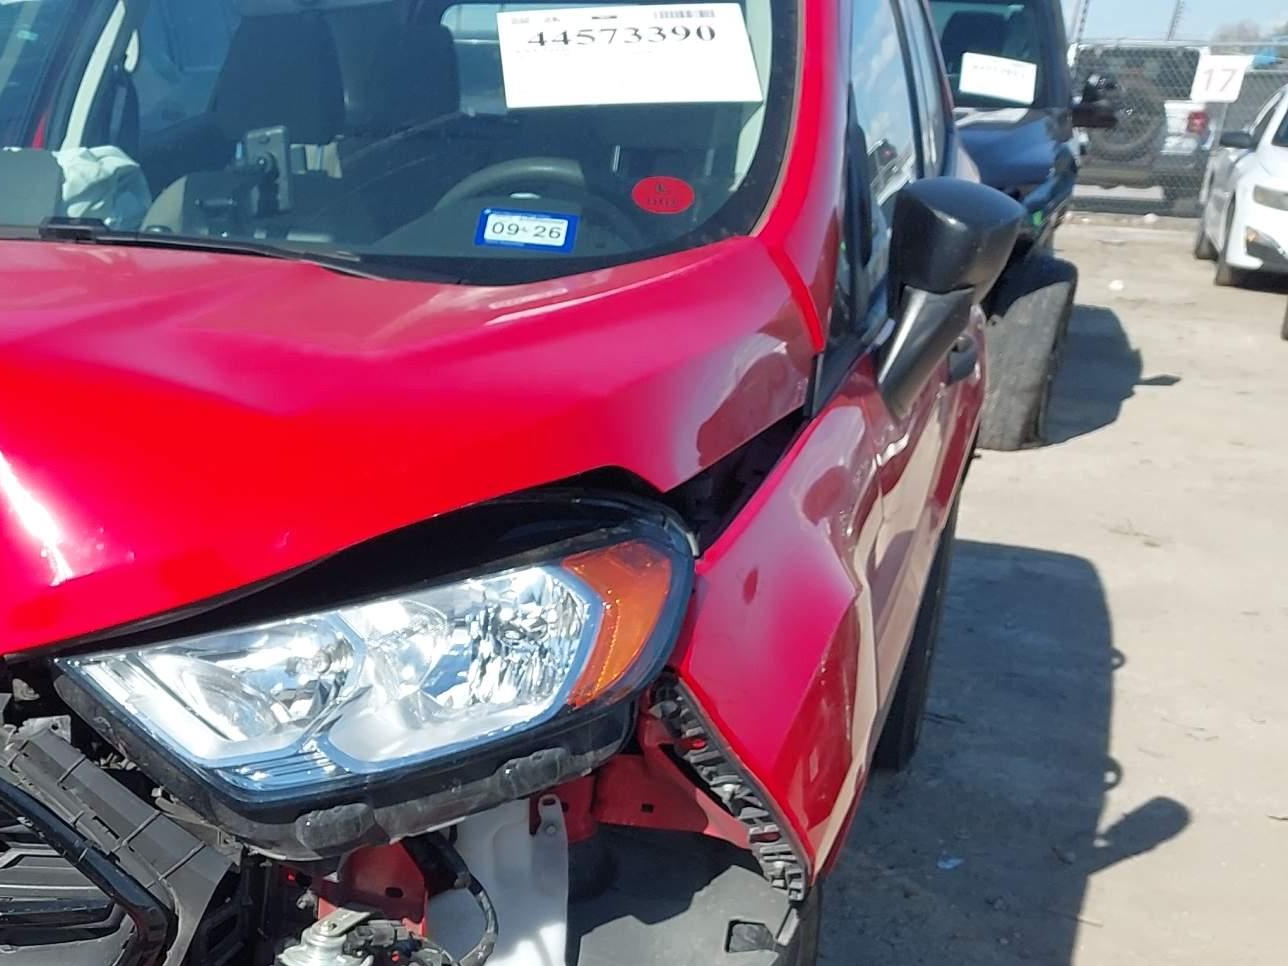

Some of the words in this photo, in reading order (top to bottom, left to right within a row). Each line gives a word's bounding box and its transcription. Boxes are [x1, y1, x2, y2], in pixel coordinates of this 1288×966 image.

[527, 25, 717, 46] 44573390
[1203, 68, 1238, 93] 17
[492, 221, 520, 235] 09
[533, 225, 561, 239] 26
